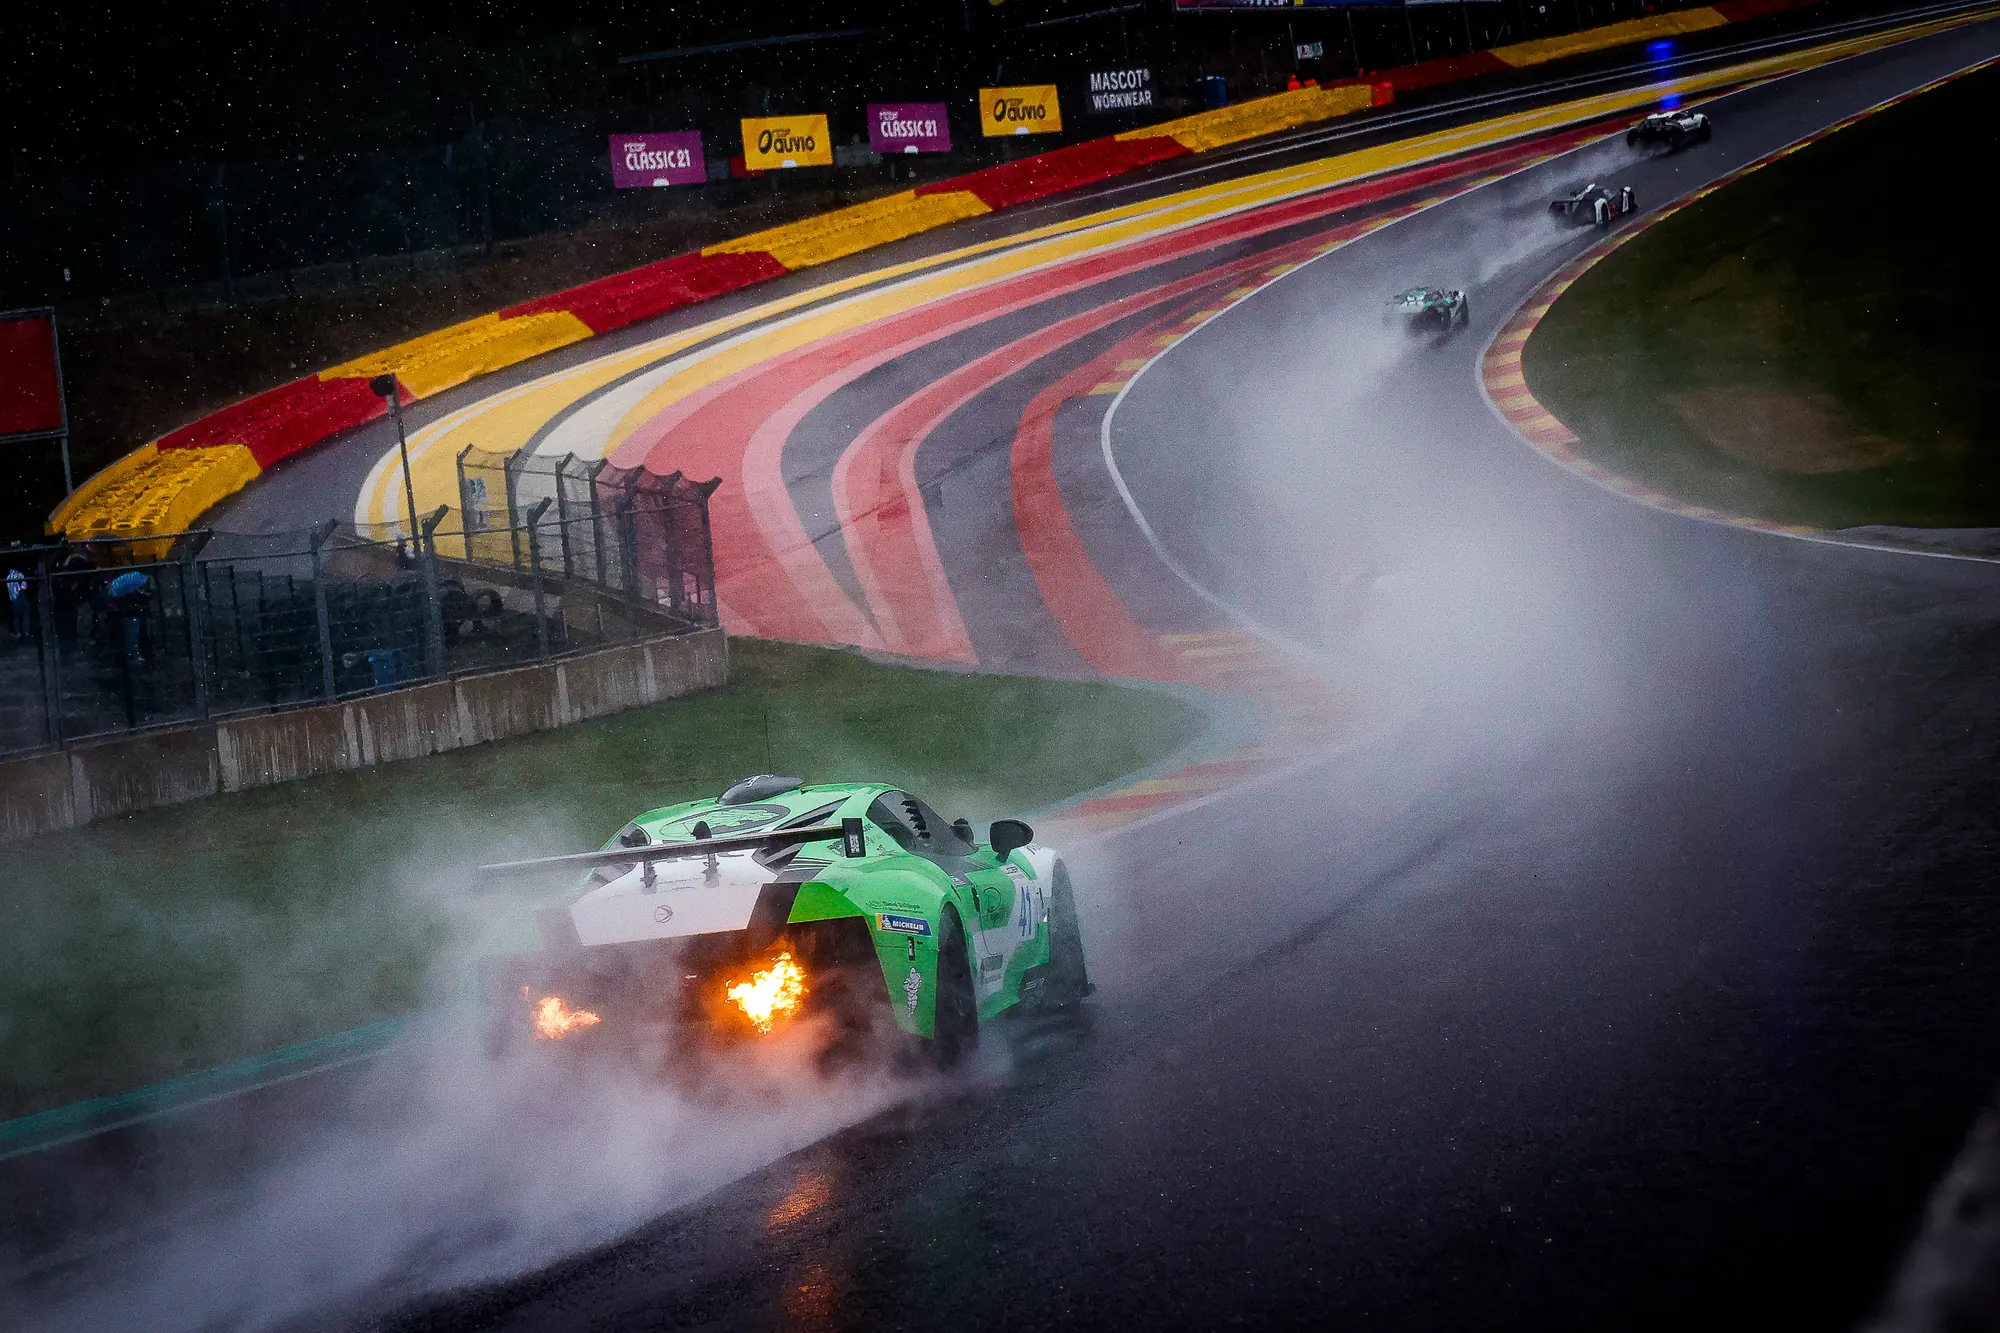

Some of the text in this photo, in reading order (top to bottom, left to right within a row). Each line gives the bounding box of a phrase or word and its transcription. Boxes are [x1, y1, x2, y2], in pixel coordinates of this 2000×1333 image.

[1092, 90, 1152, 111] WORKWEAR
[881, 119, 938, 137] CLASSIC 21
[625, 148, 691, 171] CLASSIC 21
[892, 920, 924, 931] MICHELIN
